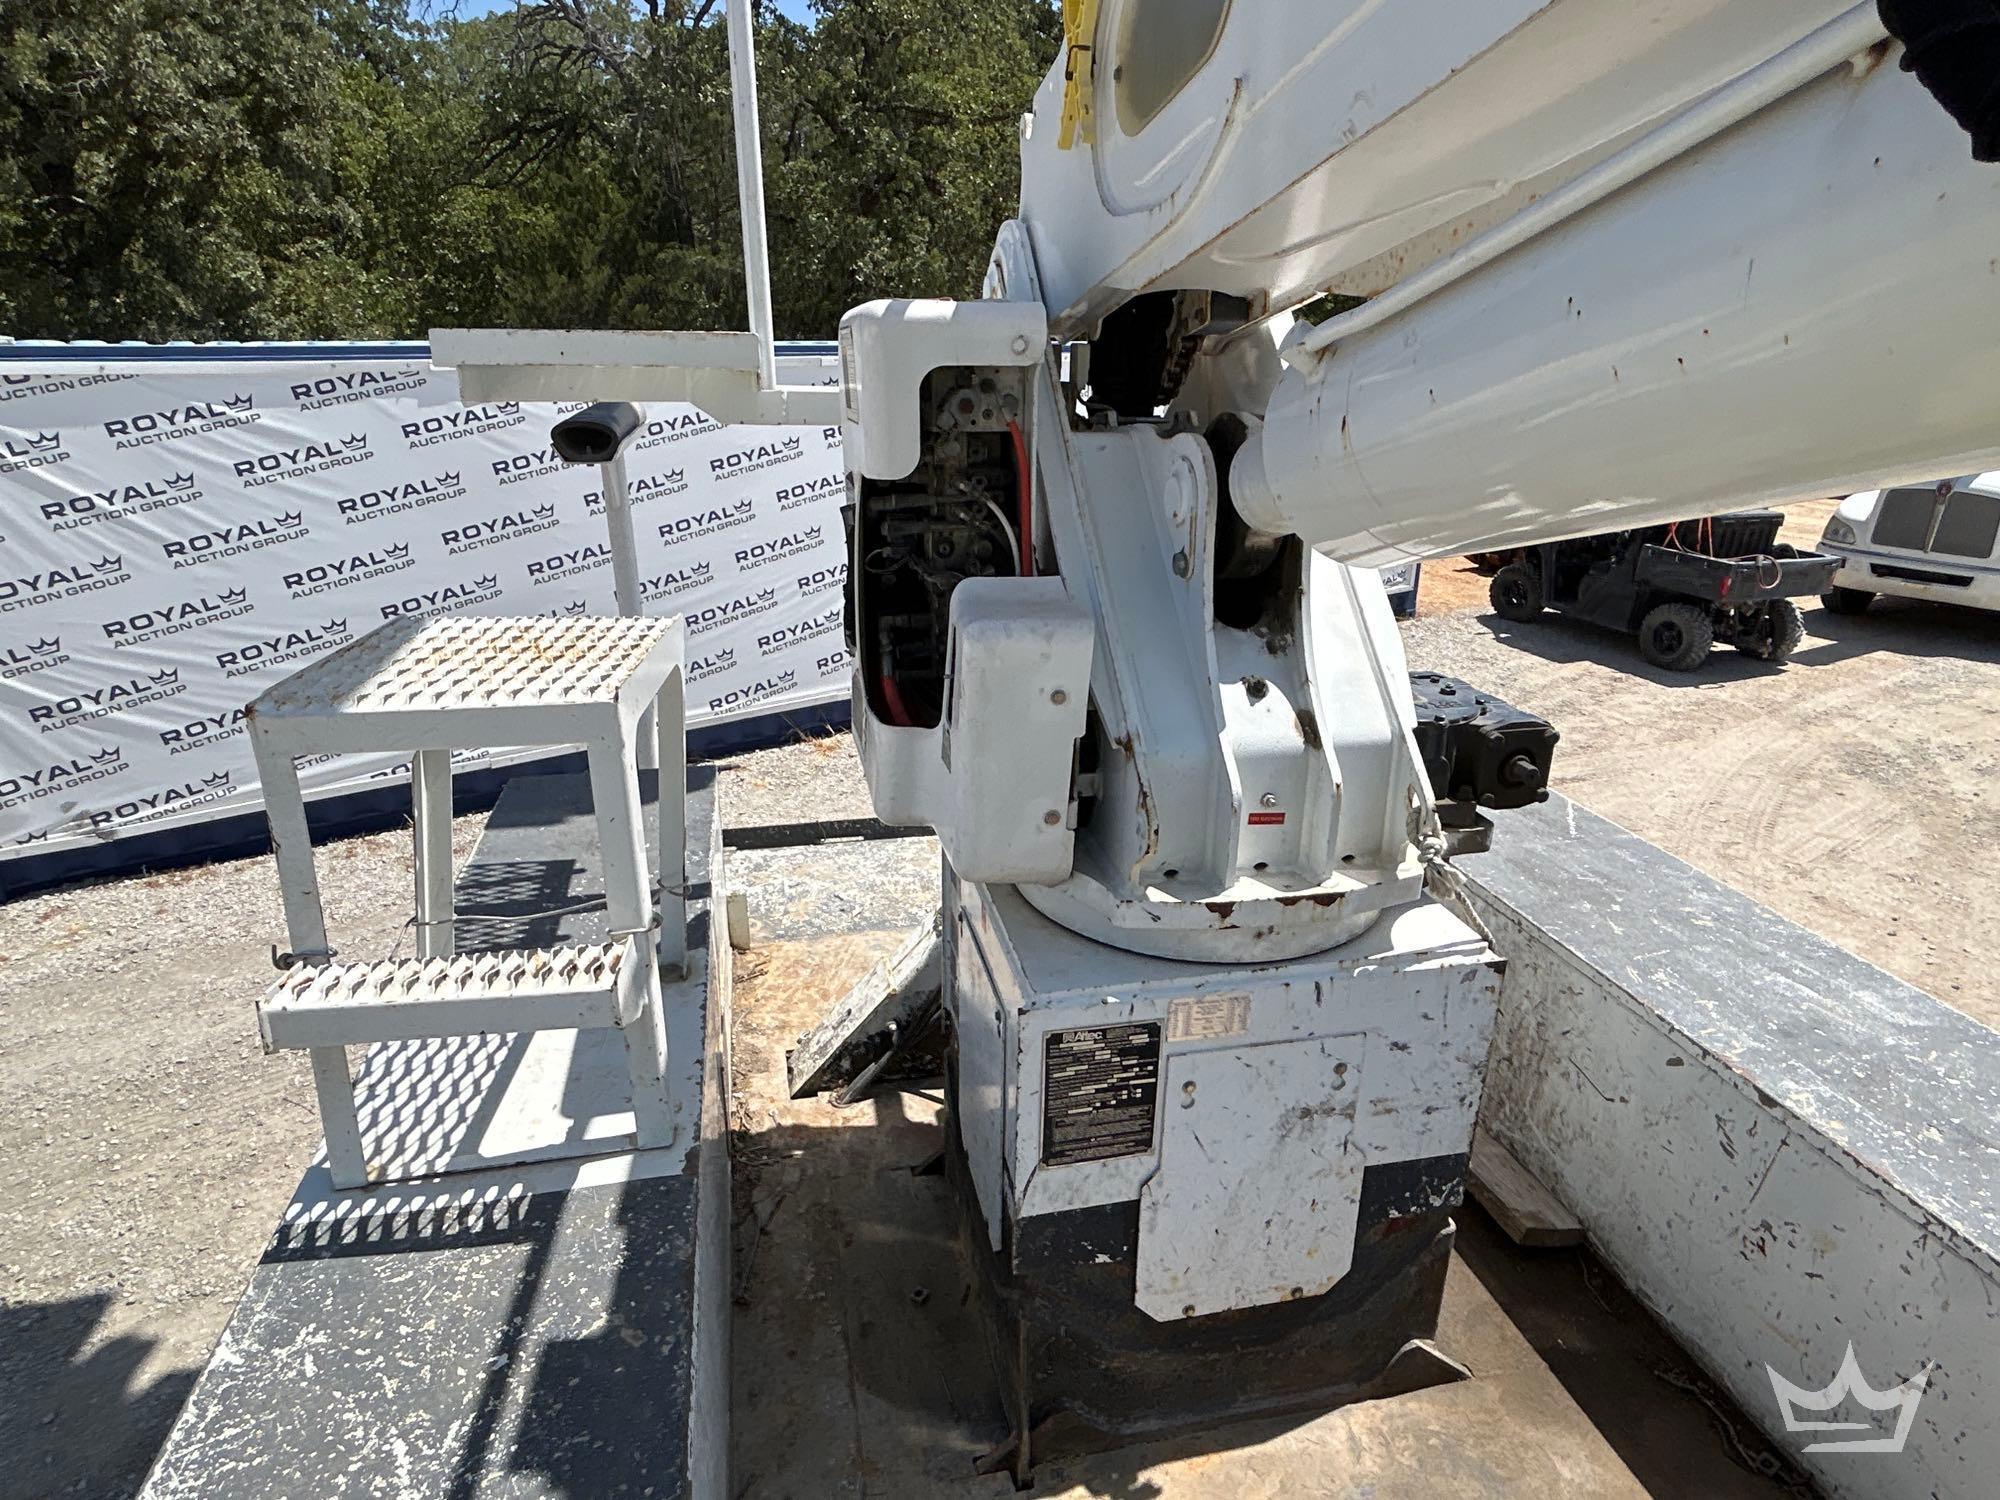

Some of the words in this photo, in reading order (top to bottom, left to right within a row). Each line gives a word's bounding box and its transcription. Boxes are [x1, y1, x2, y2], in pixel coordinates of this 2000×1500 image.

[0, 380, 75, 401] UCTION
[291, 371, 397, 400] ROYAL
[300, 390, 371, 412] AUCTION
[374, 378, 427, 396] GROUP
[104, 403, 227, 438] ROYAL
[116, 426, 198, 450] AUCTION
[201, 413, 261, 432] GROUP
[401, 406, 498, 439] ROYAL
[409, 427, 474, 449] AUCTION
[477, 415, 526, 434] GROUP
[635, 431, 689, 451] AUCTION
[691, 424, 728, 437] GROU
[641, 412, 709, 438] OYAL
[0, 452, 71, 473] GROUP
[233, 442, 343, 478] ROYAL
[243, 465, 316, 489] AUCTION
[319, 451, 374, 471] GROUP
[710, 443, 783, 472] ROYAL
[714, 462, 764, 482] AUCTION
[766, 450, 804, 467] GROUP
[499, 464, 559, 486] AUCTION
[647, 483, 688, 501] GROUP
[776, 474, 844, 503] ROYAL
[40, 482, 168, 520] ROYAL
[52, 506, 137, 532] AUCTION
[140, 491, 204, 513] GROUP
[337, 480, 438, 514] ROYAL
[346, 501, 413, 525] AUCTION
[416, 487, 467, 506] GROUP
[780, 492, 827, 512] AUCTION
[163, 521, 277, 558] ROYAL
[441, 512, 534, 546] ROYAL
[448, 533, 511, 556] AUCTION
[513, 519, 560, 538] GROUP
[658, 507, 735, 538] ROYAL
[663, 526, 715, 547] AUCTION
[717, 513, 756, 530] GROUP
[173, 543, 250, 570] AUCTION
[252, 528, 310, 549] GROUP
[527, 543, 612, 576] ROYAL
[735, 533, 805, 564] ROYAL
[739, 551, 787, 572] AUCTION
[788, 539, 825, 556] GROUP
[0, 566, 94, 600] OYAL
[283, 552, 386, 589] ROYAL
[292, 574, 361, 600] AUCTION
[363, 558, 416, 579] GROUP
[533, 563, 591, 586] AUCTION
[797, 563, 849, 589] ROYA
[801, 577, 846, 598] AUCTION
[0, 590, 62, 613] CTION
[65, 573, 132, 596] GROUP
[381, 584, 476, 619] ROYAL
[455, 589, 503, 610] GROUP
[640, 589, 672, 604] TION
[674, 575, 714, 594] GROUP
[102, 598, 221, 638] ROYAL
[114, 621, 193, 649] AUCTION
[195, 603, 255, 627] GROUP
[685, 596, 758, 628] ROYAL
[689, 615, 739, 636] AUCTION
[741, 601, 778, 619] GROUP
[216, 629, 324, 669] ROYAL
[757, 617, 825, 649] ROYAL
[761, 635, 807, 657] AUCTION
[809, 622, 843, 639] GROUP
[2, 654, 71, 679] GROUP
[226, 651, 298, 679] AUCTION
[300, 633, 354, 656] GROUP
[699, 660, 738, 679] GROUP
[28, 679, 152, 723] ROYAL
[709, 678, 779, 712] ROYAL
[762, 681, 799, 699] GROUP
[40, 703, 123, 734] AUCTION
[125, 684, 187, 709] GROUP
[159, 708, 247, 746] ROYA
[169, 726, 244, 755] AUCTION
[0, 759, 93, 797] OYAL
[0, 783, 63, 811] CTION
[65, 762, 130, 788] GROUP
[90, 783, 205, 828] ROYAL
[179, 785, 238, 811] GROUP
